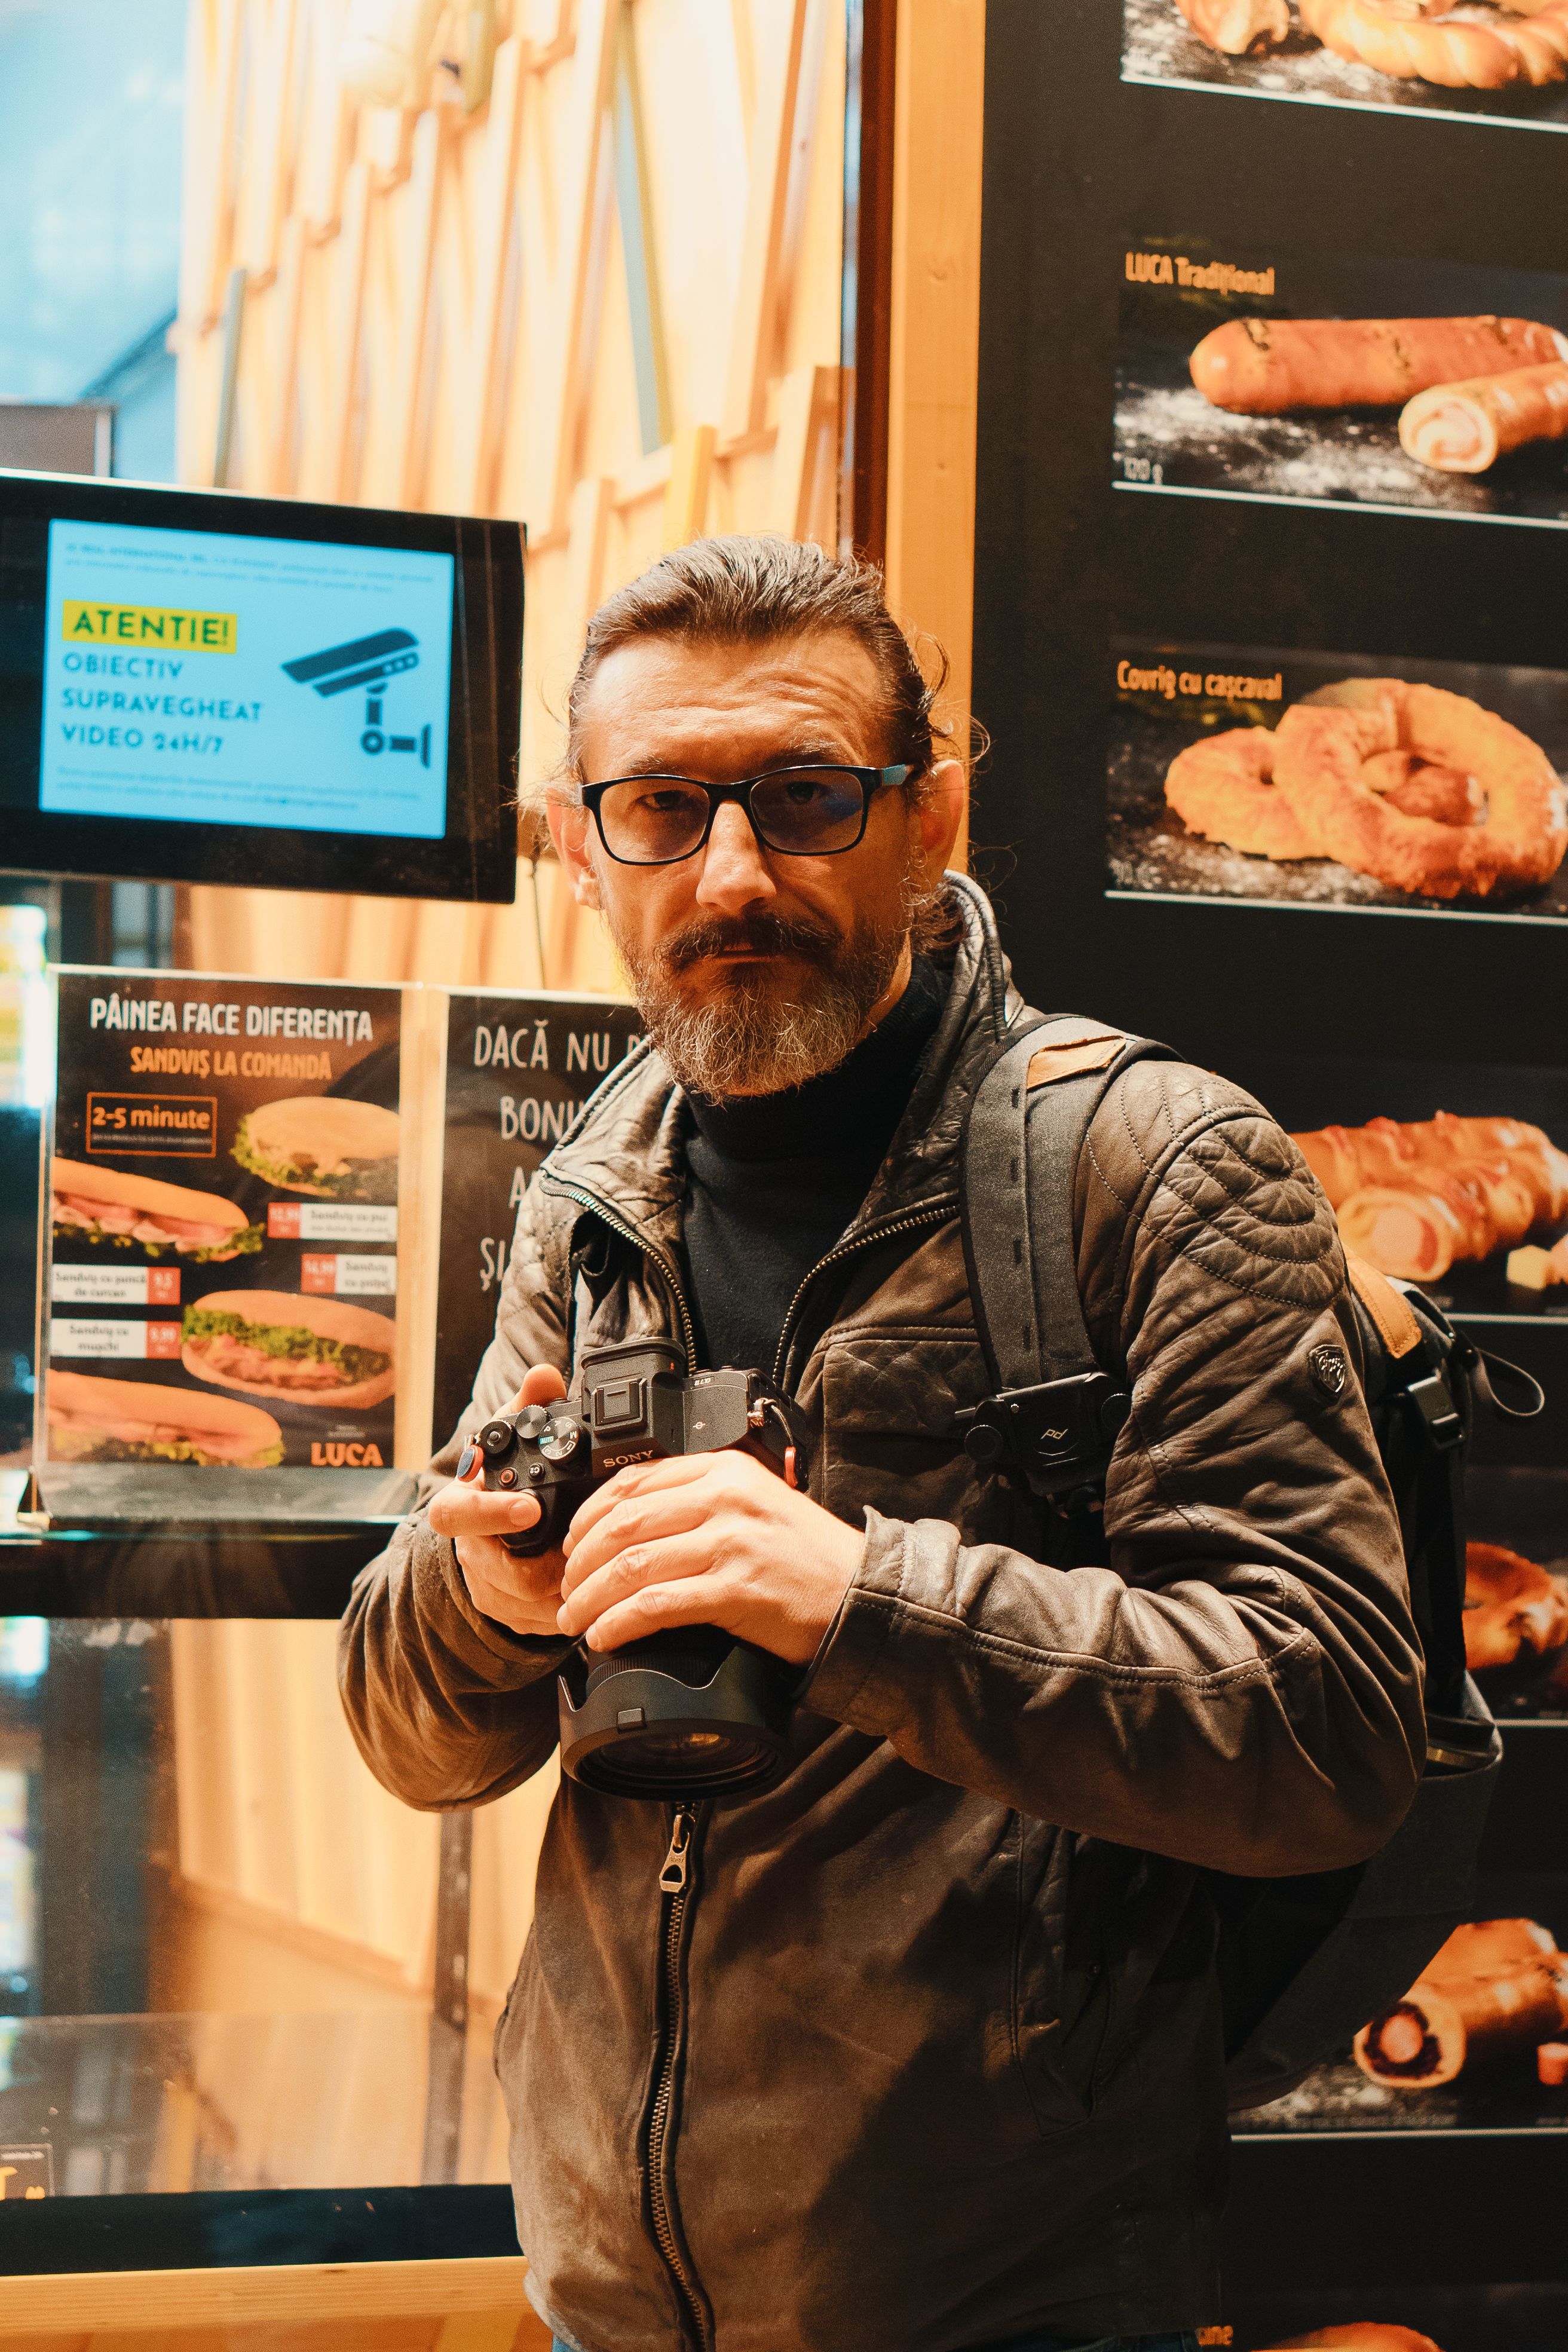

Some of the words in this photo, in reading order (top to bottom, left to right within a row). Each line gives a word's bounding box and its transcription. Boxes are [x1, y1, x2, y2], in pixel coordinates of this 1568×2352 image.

[1126, 252, 1174, 285] LUCA
[73, 610, 228, 646] ATENTIE!
[63, 652, 183, 679] OBIECTIV
[1117, 660, 1176, 700] Covrig
[1179, 672, 1202, 695] cu
[62, 688, 262, 723] SUPRAVEGHEAT
[62, 723, 143, 748] VIDEO
[153, 731, 223, 755] 24H/7
[90, 993, 177, 1033] PÂINEA
[182, 1002, 240, 1036] FACE
[473, 1019, 549, 1070] DACĂ
[566, 1031, 610, 1071] NU
[213, 1050, 239, 1076] LA
[93, 1107, 127, 1129] 2-5
[130, 1104, 210, 1129] minute
[311, 1442, 383, 1467] LUCA
[603, 1450, 654, 1468] SONY
